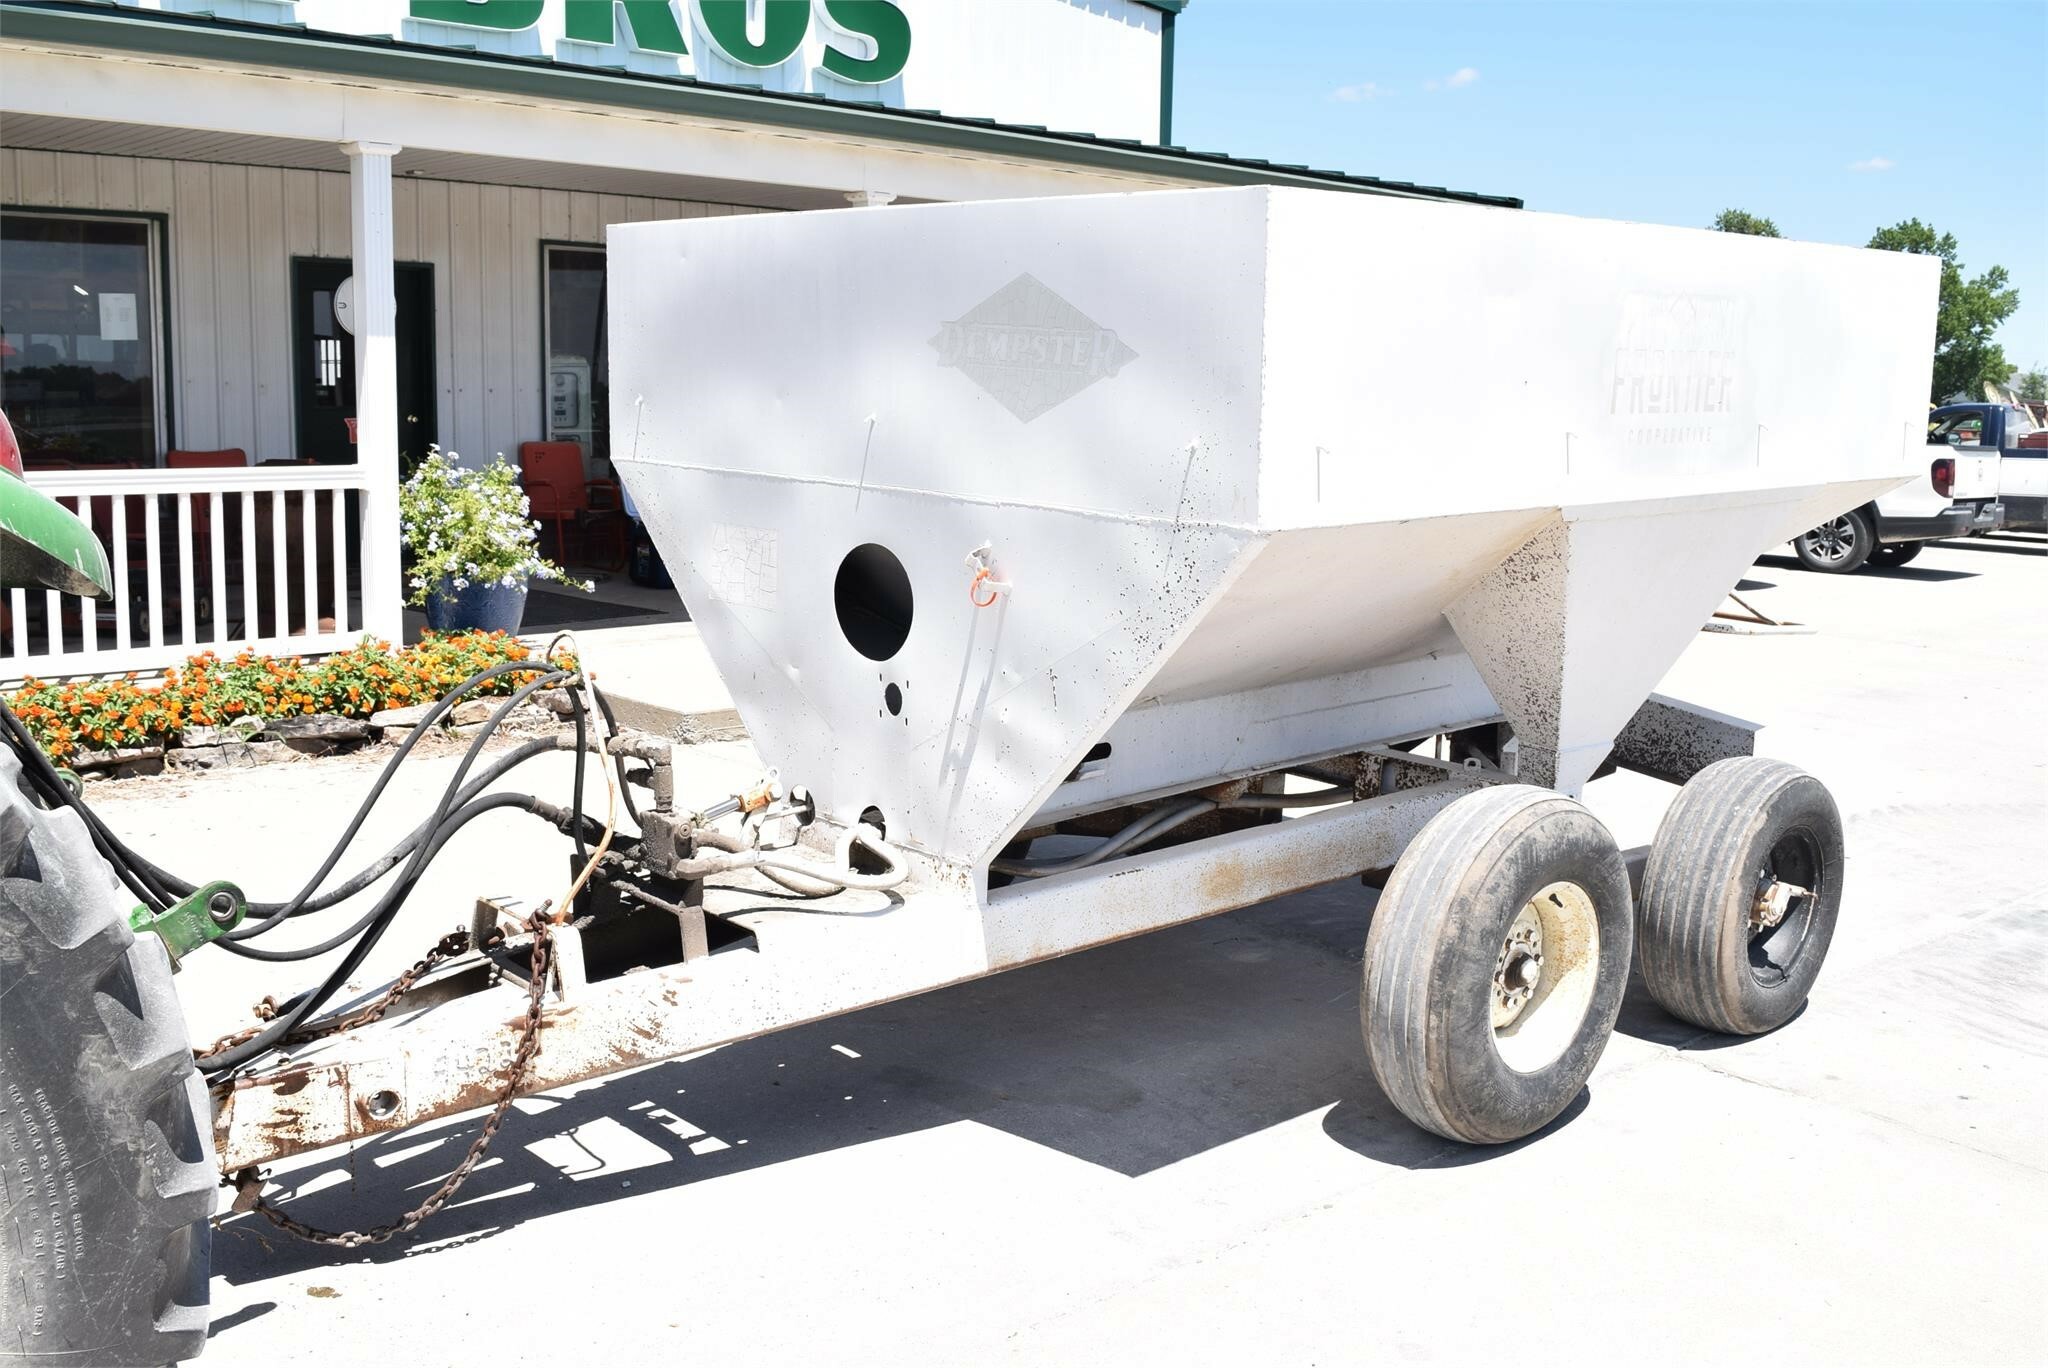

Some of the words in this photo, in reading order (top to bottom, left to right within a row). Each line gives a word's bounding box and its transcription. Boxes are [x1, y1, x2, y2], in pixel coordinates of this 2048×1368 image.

[408, 0, 913, 84] OS
[938, 322, 1118, 377] DEMPSTER
[33, 1088, 60, 1135] TRACTOR
[8, 1084, 25, 1106] MAX
[20, 1108, 39, 1136] LOAD
[32, 1138, 44, 1153] AT
[44, 1173, 57, 1198] MPH
[54, 1136, 71, 1169] DRIVE
[65, 1171, 80, 1209] WHEEL
[72, 1213, 85, 1260] SERVICE
